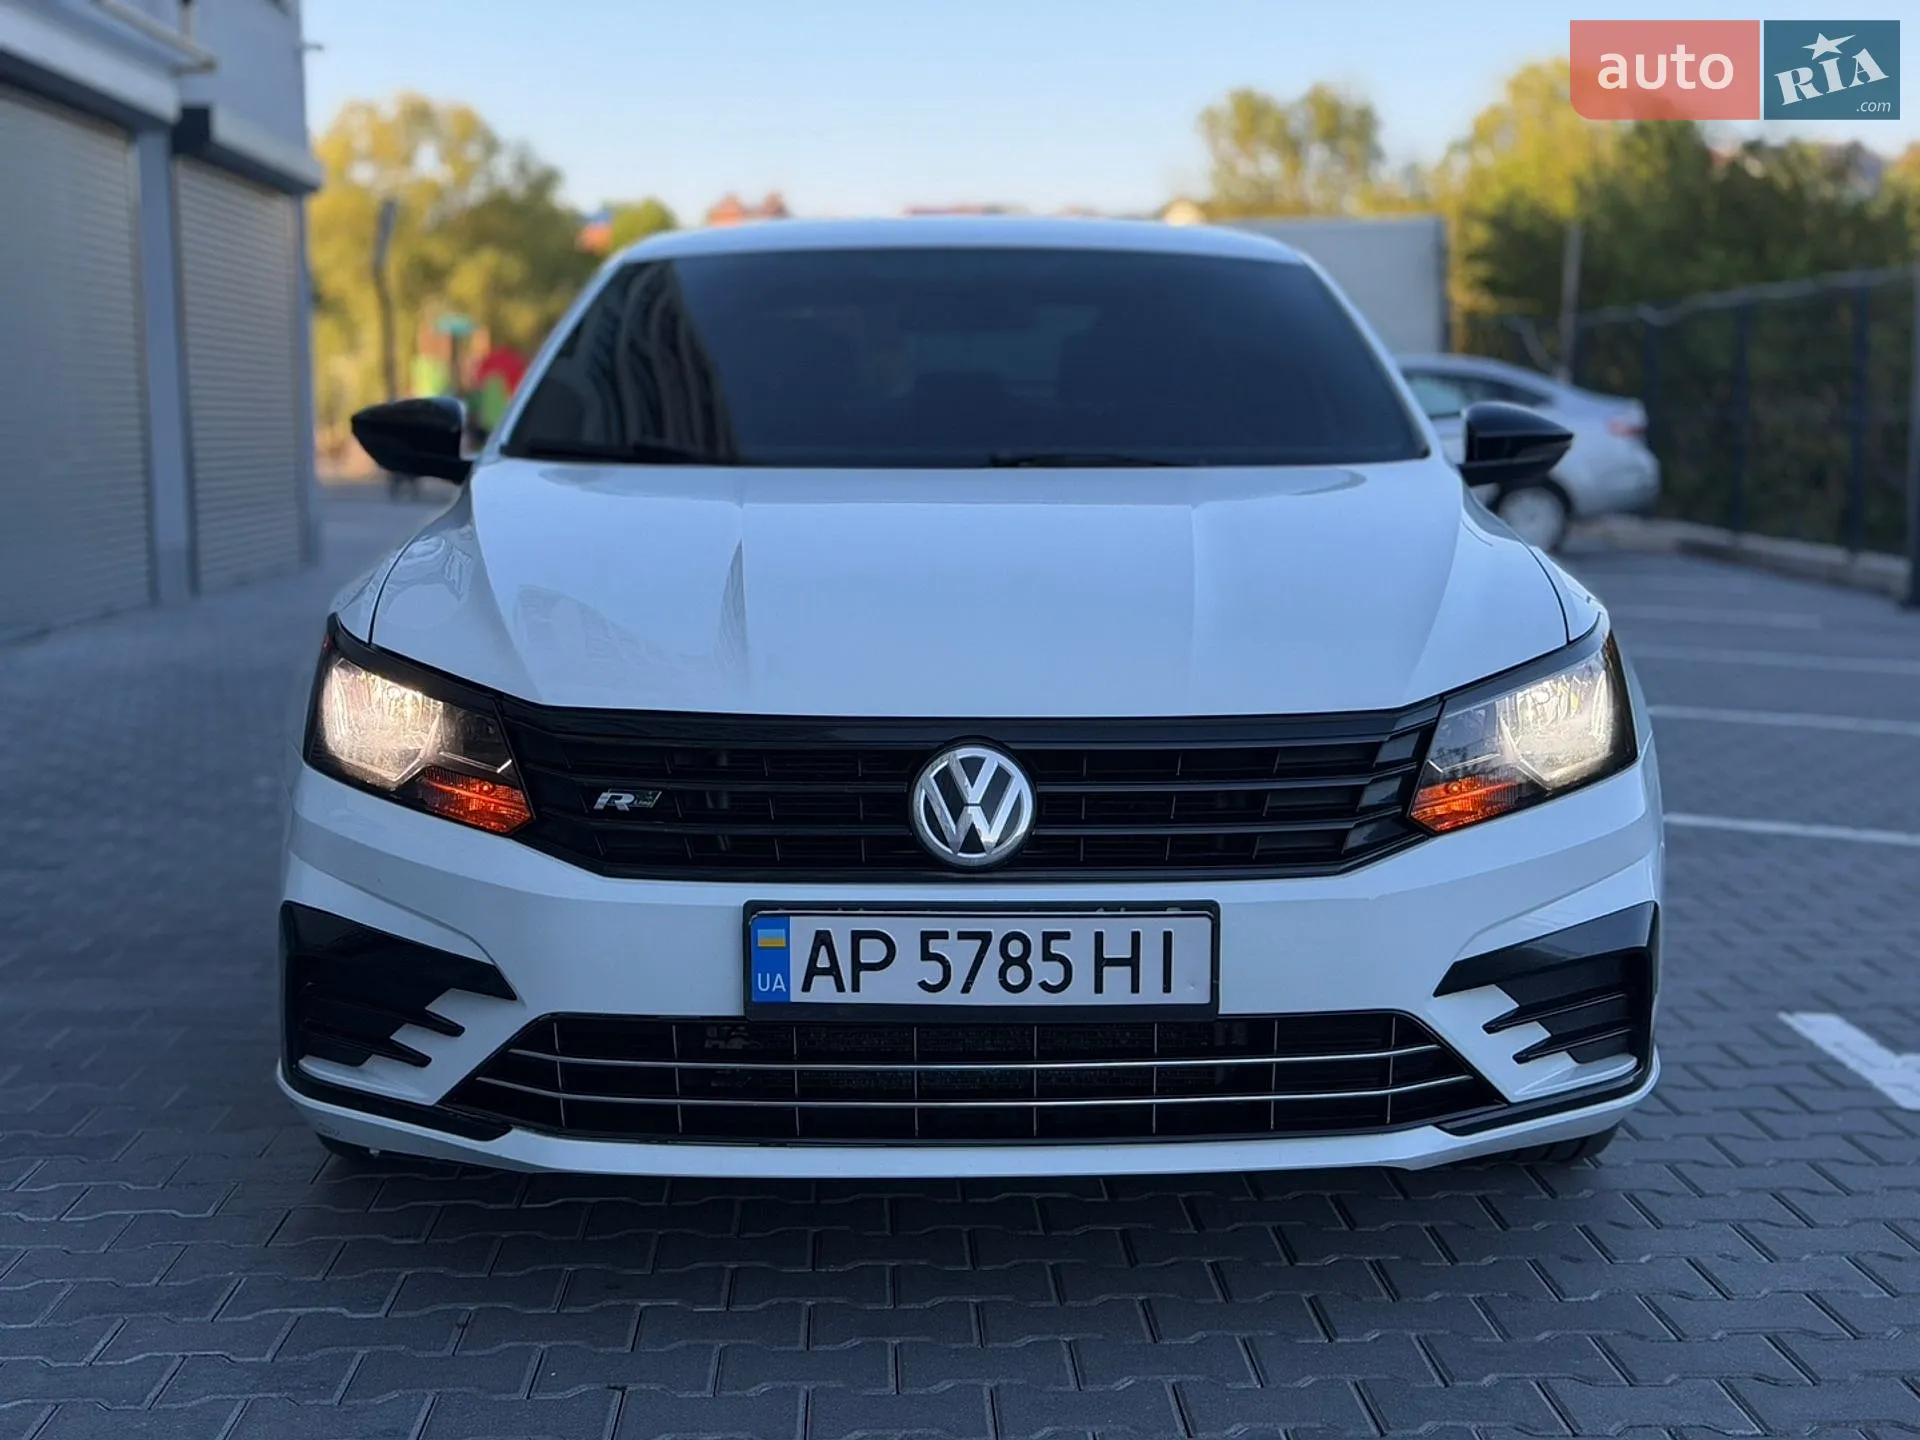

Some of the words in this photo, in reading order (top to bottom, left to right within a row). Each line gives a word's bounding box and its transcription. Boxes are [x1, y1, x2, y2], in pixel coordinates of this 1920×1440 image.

[757, 972, 787, 993] UA
[801, 929, 898, 994] AP
[916, 929, 1074, 995] 5785
[1093, 929, 1174, 995] HI
